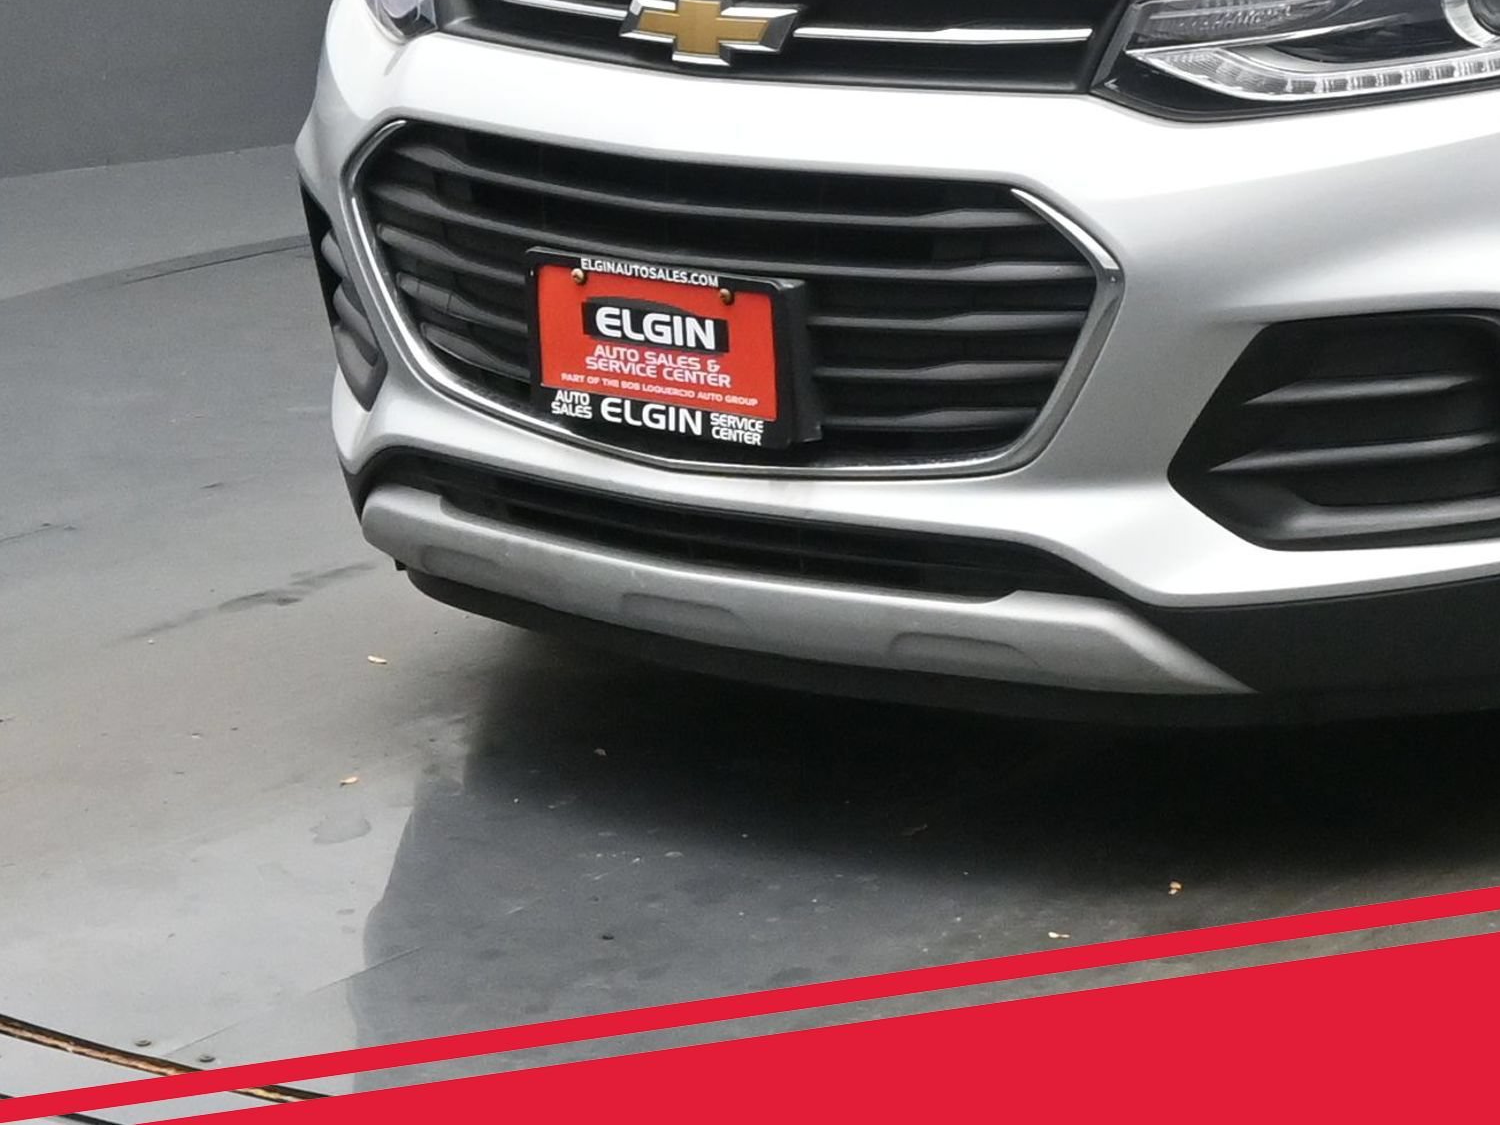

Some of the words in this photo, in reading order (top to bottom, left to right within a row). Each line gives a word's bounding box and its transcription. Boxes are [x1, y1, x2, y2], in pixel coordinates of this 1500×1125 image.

[580, 258, 719, 288] ELGINAUTOSALES.COM
[595, 306, 716, 350] ELGIN
[585, 357, 658, 379] SERVICE
[662, 369, 732, 389] CENTER
[593, 345, 640, 363] AUTO
[643, 352, 701, 371] SALES
[706, 359, 721, 373] &
[555, 389, 590, 406] AUTO
[561, 373, 585, 383] PART
[587, 376, 600, 385] OF
[697, 392, 724, 402] AUTO
[724, 395, 759, 407] GROUP
[551, 401, 593, 420] SALES
[600, 397, 703, 436] ELGIN
[710, 412, 765, 434] SERVICE
[711, 426, 762, 447] CENTER
